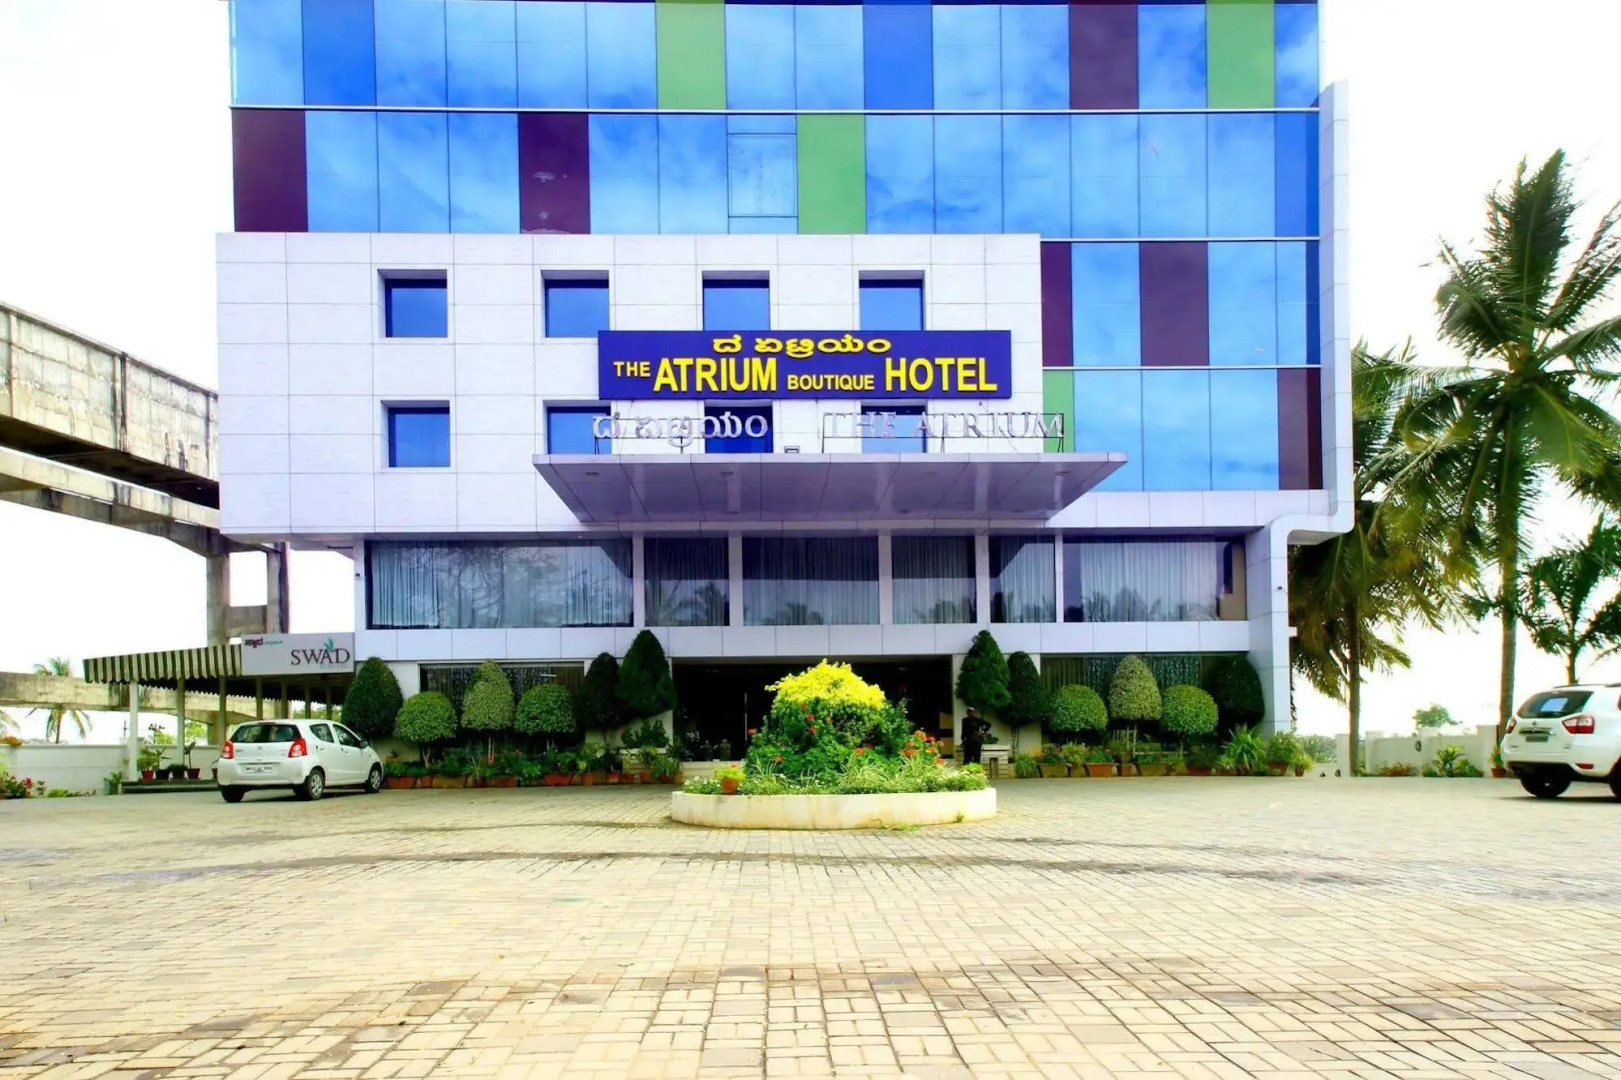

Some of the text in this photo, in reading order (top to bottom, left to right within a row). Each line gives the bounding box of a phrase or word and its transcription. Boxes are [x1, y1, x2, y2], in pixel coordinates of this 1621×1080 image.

[613, 357, 998, 393] THE ATRIUM BOUTIQUE HOTEL
[825, 411, 1065, 438] THE ATRIUM
[290, 647, 351, 666] SWAD
